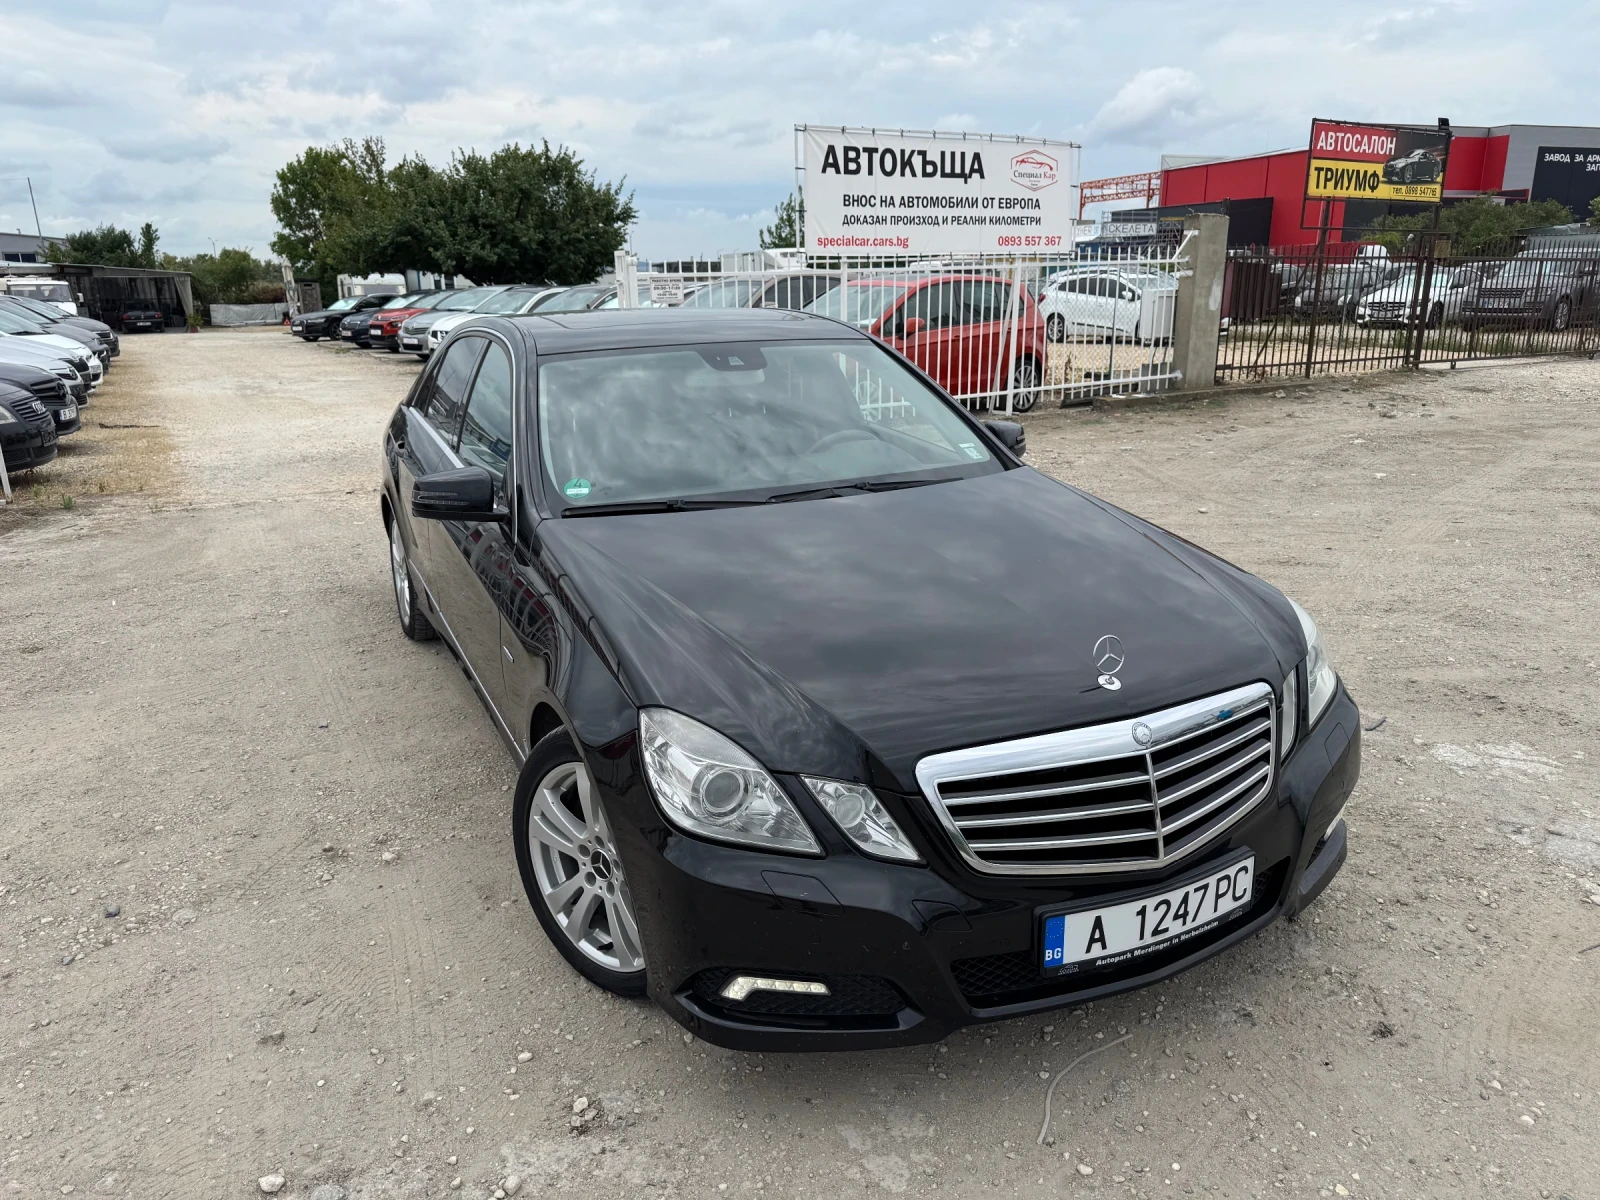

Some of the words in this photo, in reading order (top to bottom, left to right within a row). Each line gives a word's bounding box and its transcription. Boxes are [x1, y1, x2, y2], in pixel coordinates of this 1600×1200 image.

[1317, 131, 1397, 155] АВТОСАЛОН
[821, 144, 985, 184] АВТОКЪЩА
[1544, 153, 1570, 163] ЗАВОД
[1574, 154, 1584, 162] ЗА
[1013, 169, 1042, 179] Специал
[1043, 171, 1056, 181] Кар
[1314, 166, 1380, 193] ТРИУМФ
[843, 194, 877, 208] ВНОС
[880, 195, 896, 208] НА
[899, 195, 979, 210] АВТОМОБИЛИ
[982, 197, 995, 209] ОТ
[998, 197, 1041, 210] ЕВРОПА
[842, 214, 888, 227] ДОКАЗАН
[890, 215, 940, 227] ПРОИЗХОД
[942, 216, 949, 226] И
[950, 216, 986, 226] РЕАЛНИ
[989, 216, 1041, 226] КИЛОМЕТРИ
[817, 235, 909, 248] specialcar.cars.bg
[997, 236, 1022, 246] 0893
[1024, 236, 1042, 246] 557
[1044, 236, 1062, 246] 367
[574, 478, 583, 488] 4
[1085, 915, 1108, 954] A
[1045, 948, 1062, 961] BG
[1095, 951, 1132, 966] Autopark
[1133, 940, 1171, 957] Merdinger
[1172, 935, 1179, 945] in
